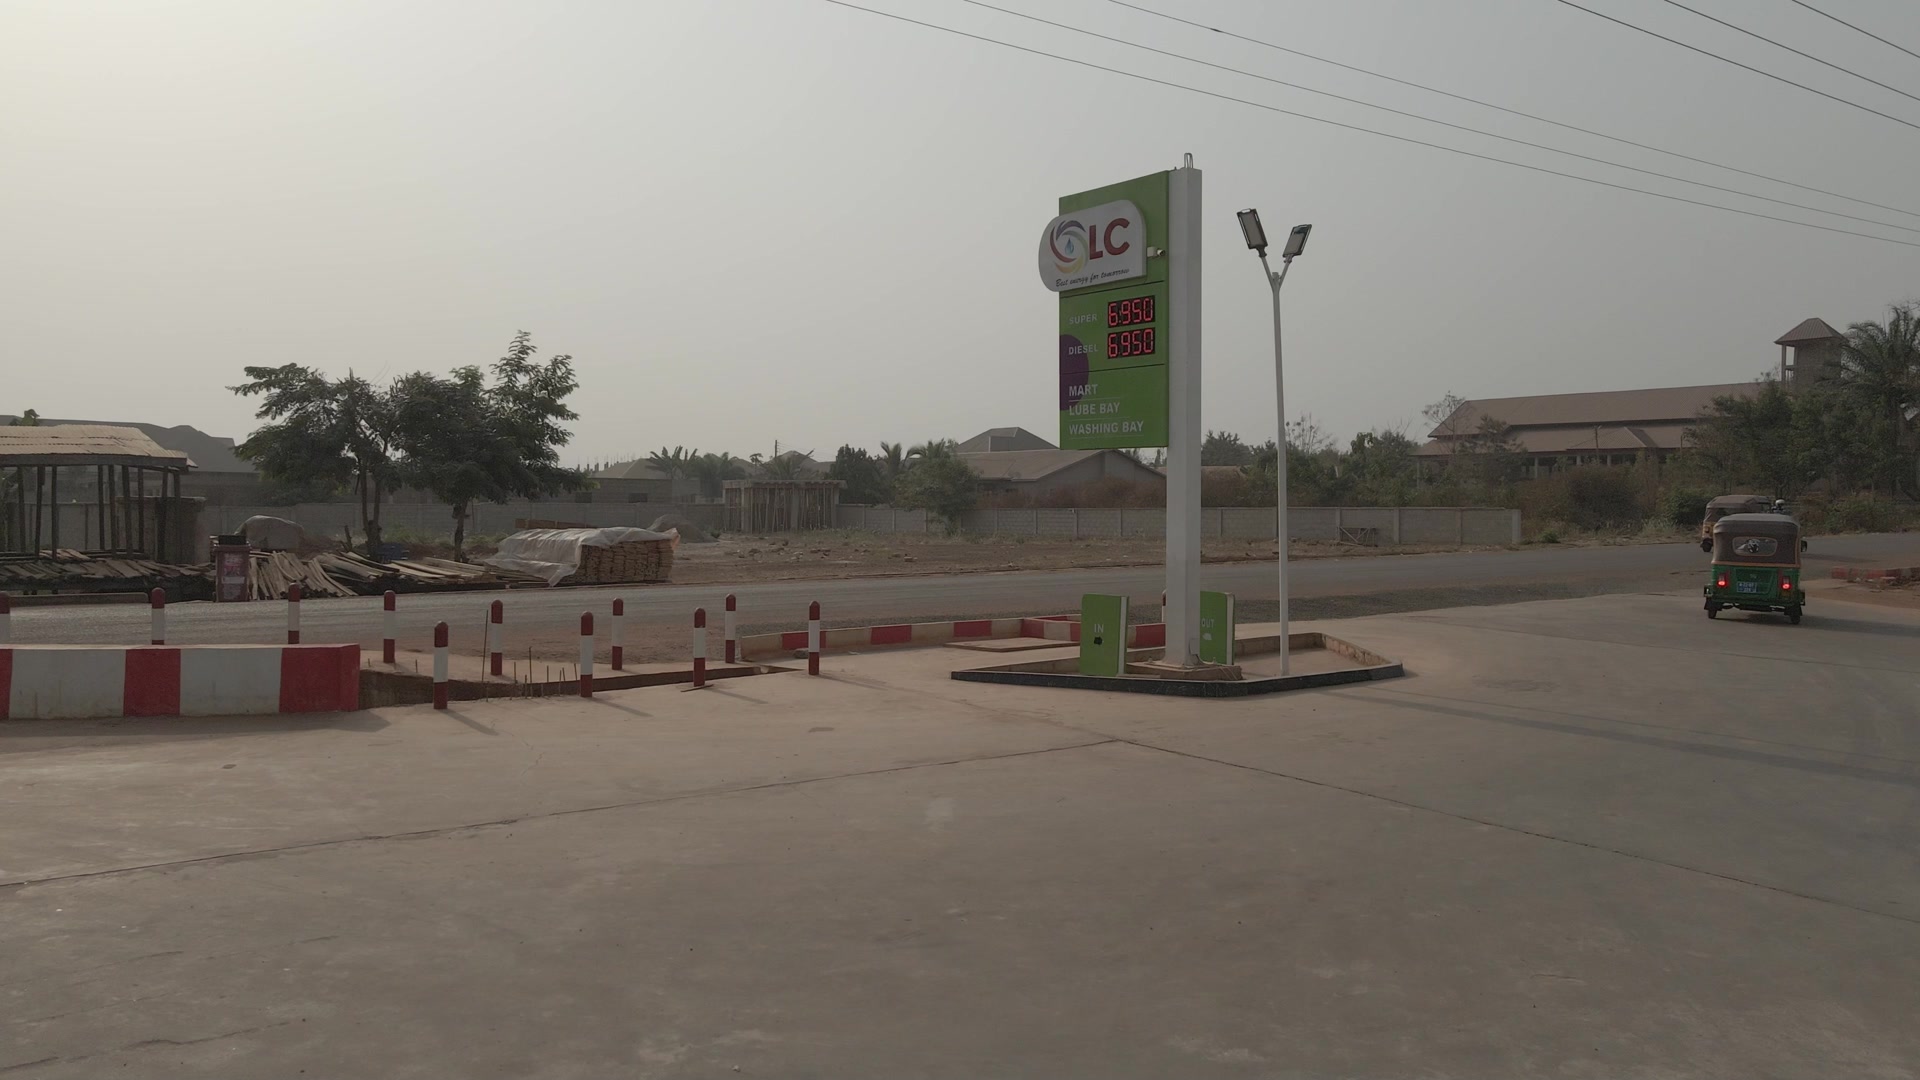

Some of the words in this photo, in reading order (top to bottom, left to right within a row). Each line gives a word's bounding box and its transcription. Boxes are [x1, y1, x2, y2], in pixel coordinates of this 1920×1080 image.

[1069, 276, 1089, 285] energy
[1089, 273, 1099, 283] for
[1100, 268, 1130, 279] tomorrow
[1069, 313, 1098, 325] SUPER
[1068, 344, 1098, 355] DIESEL
[1068, 384, 1098, 397] MART
[1069, 404, 1096, 416] LUBE
[1099, 402, 1120, 414] BAY
[1069, 422, 1119, 435] WASHING
[1122, 420, 1144, 433] BAY
[1094, 623, 1104, 633] IN
[1201, 618, 1215, 629] OUT
